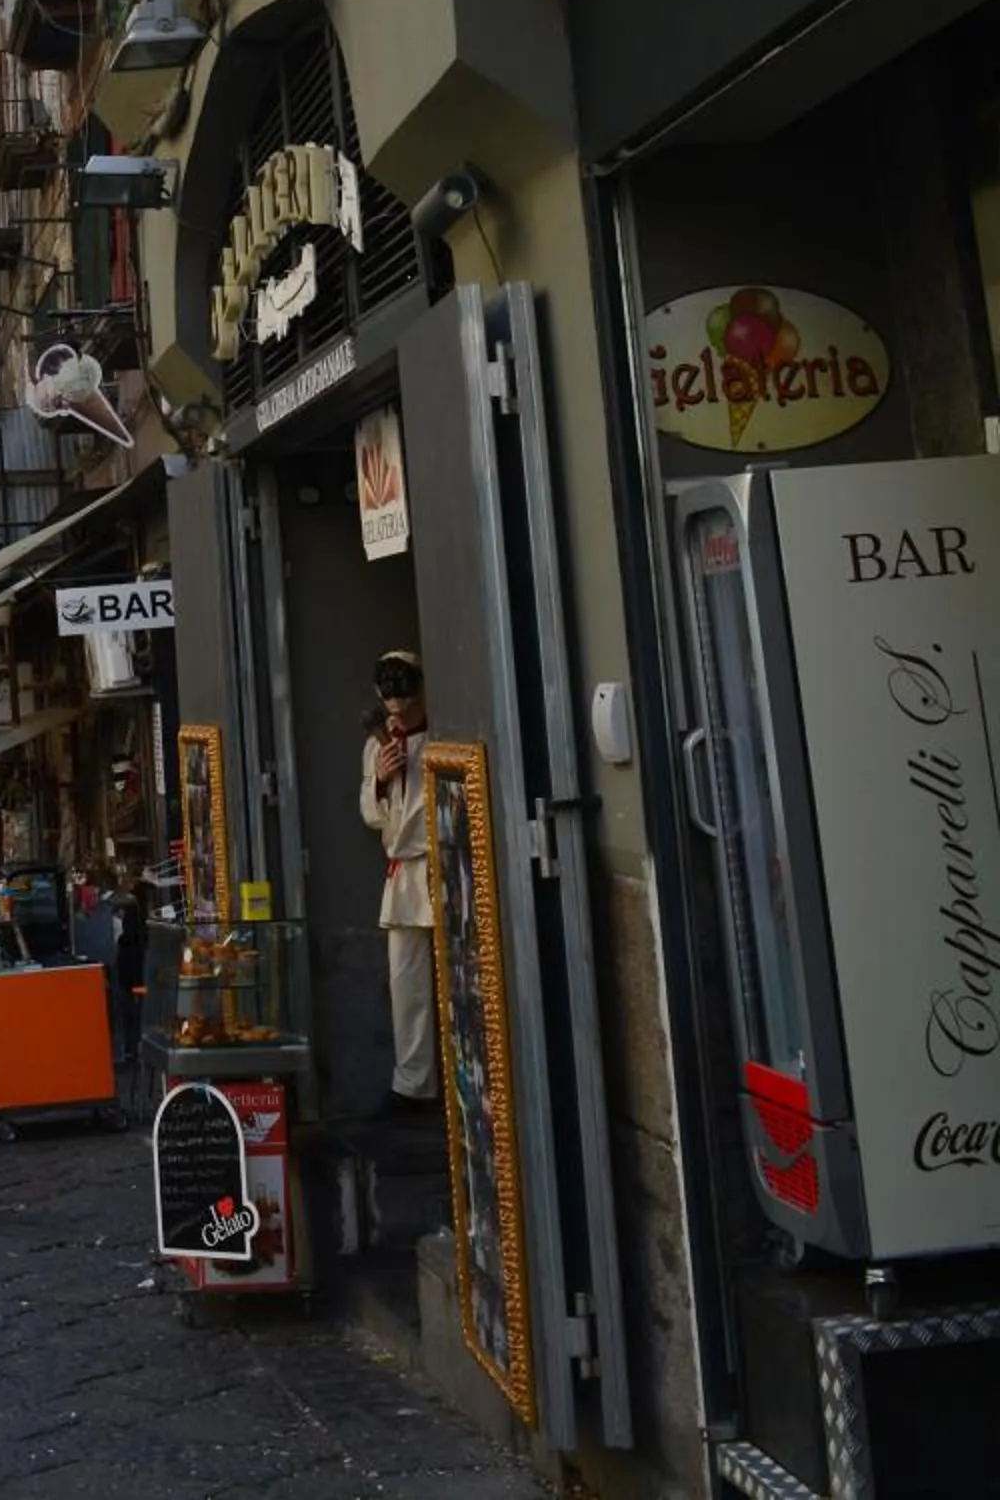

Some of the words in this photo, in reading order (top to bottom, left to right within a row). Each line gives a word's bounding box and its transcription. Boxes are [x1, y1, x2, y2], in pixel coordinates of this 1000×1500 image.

[842, 525, 975, 584] BAR
[98, 589, 175, 622] BAR
[926, 747, 1000, 1077] Capparelli
[914, 1112, 1000, 1172] Coca-
